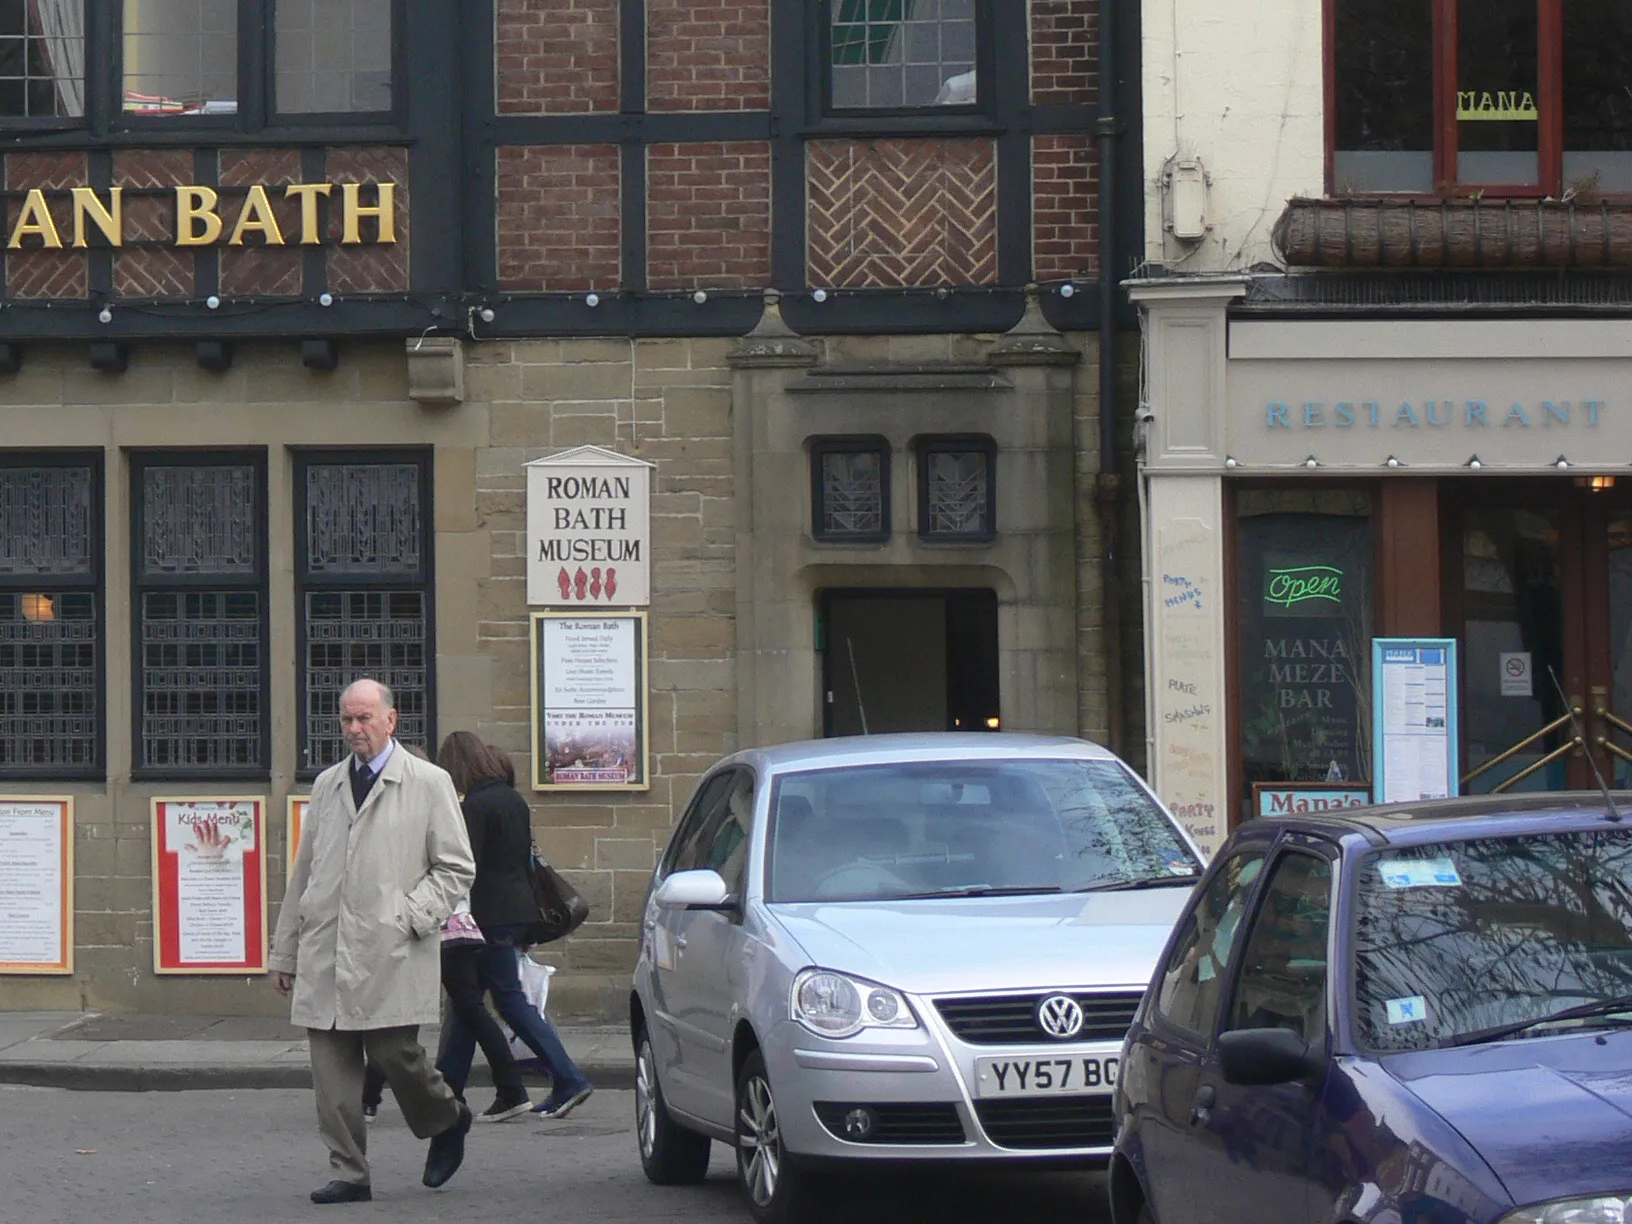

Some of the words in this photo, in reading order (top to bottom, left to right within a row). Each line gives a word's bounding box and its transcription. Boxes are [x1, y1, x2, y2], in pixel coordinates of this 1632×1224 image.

[1457, 91, 1536, 114] MANA
[174, 182, 397, 246] BATH
[1266, 399, 1607, 428] RESTAURANT
[546, 477, 630, 499] ROMAN
[553, 507, 627, 530] BATH
[538, 538, 641, 562] MUSEUM
[1269, 575, 1341, 608] Open
[1264, 639, 1348, 658] MANA
[1269, 664, 1345, 683] MEZE
[1280, 689, 1333, 708] BAR
[178, 812, 203, 825] Kids
[206, 812, 241, 826] Menu
[991, 1059, 1072, 1091] YY57
